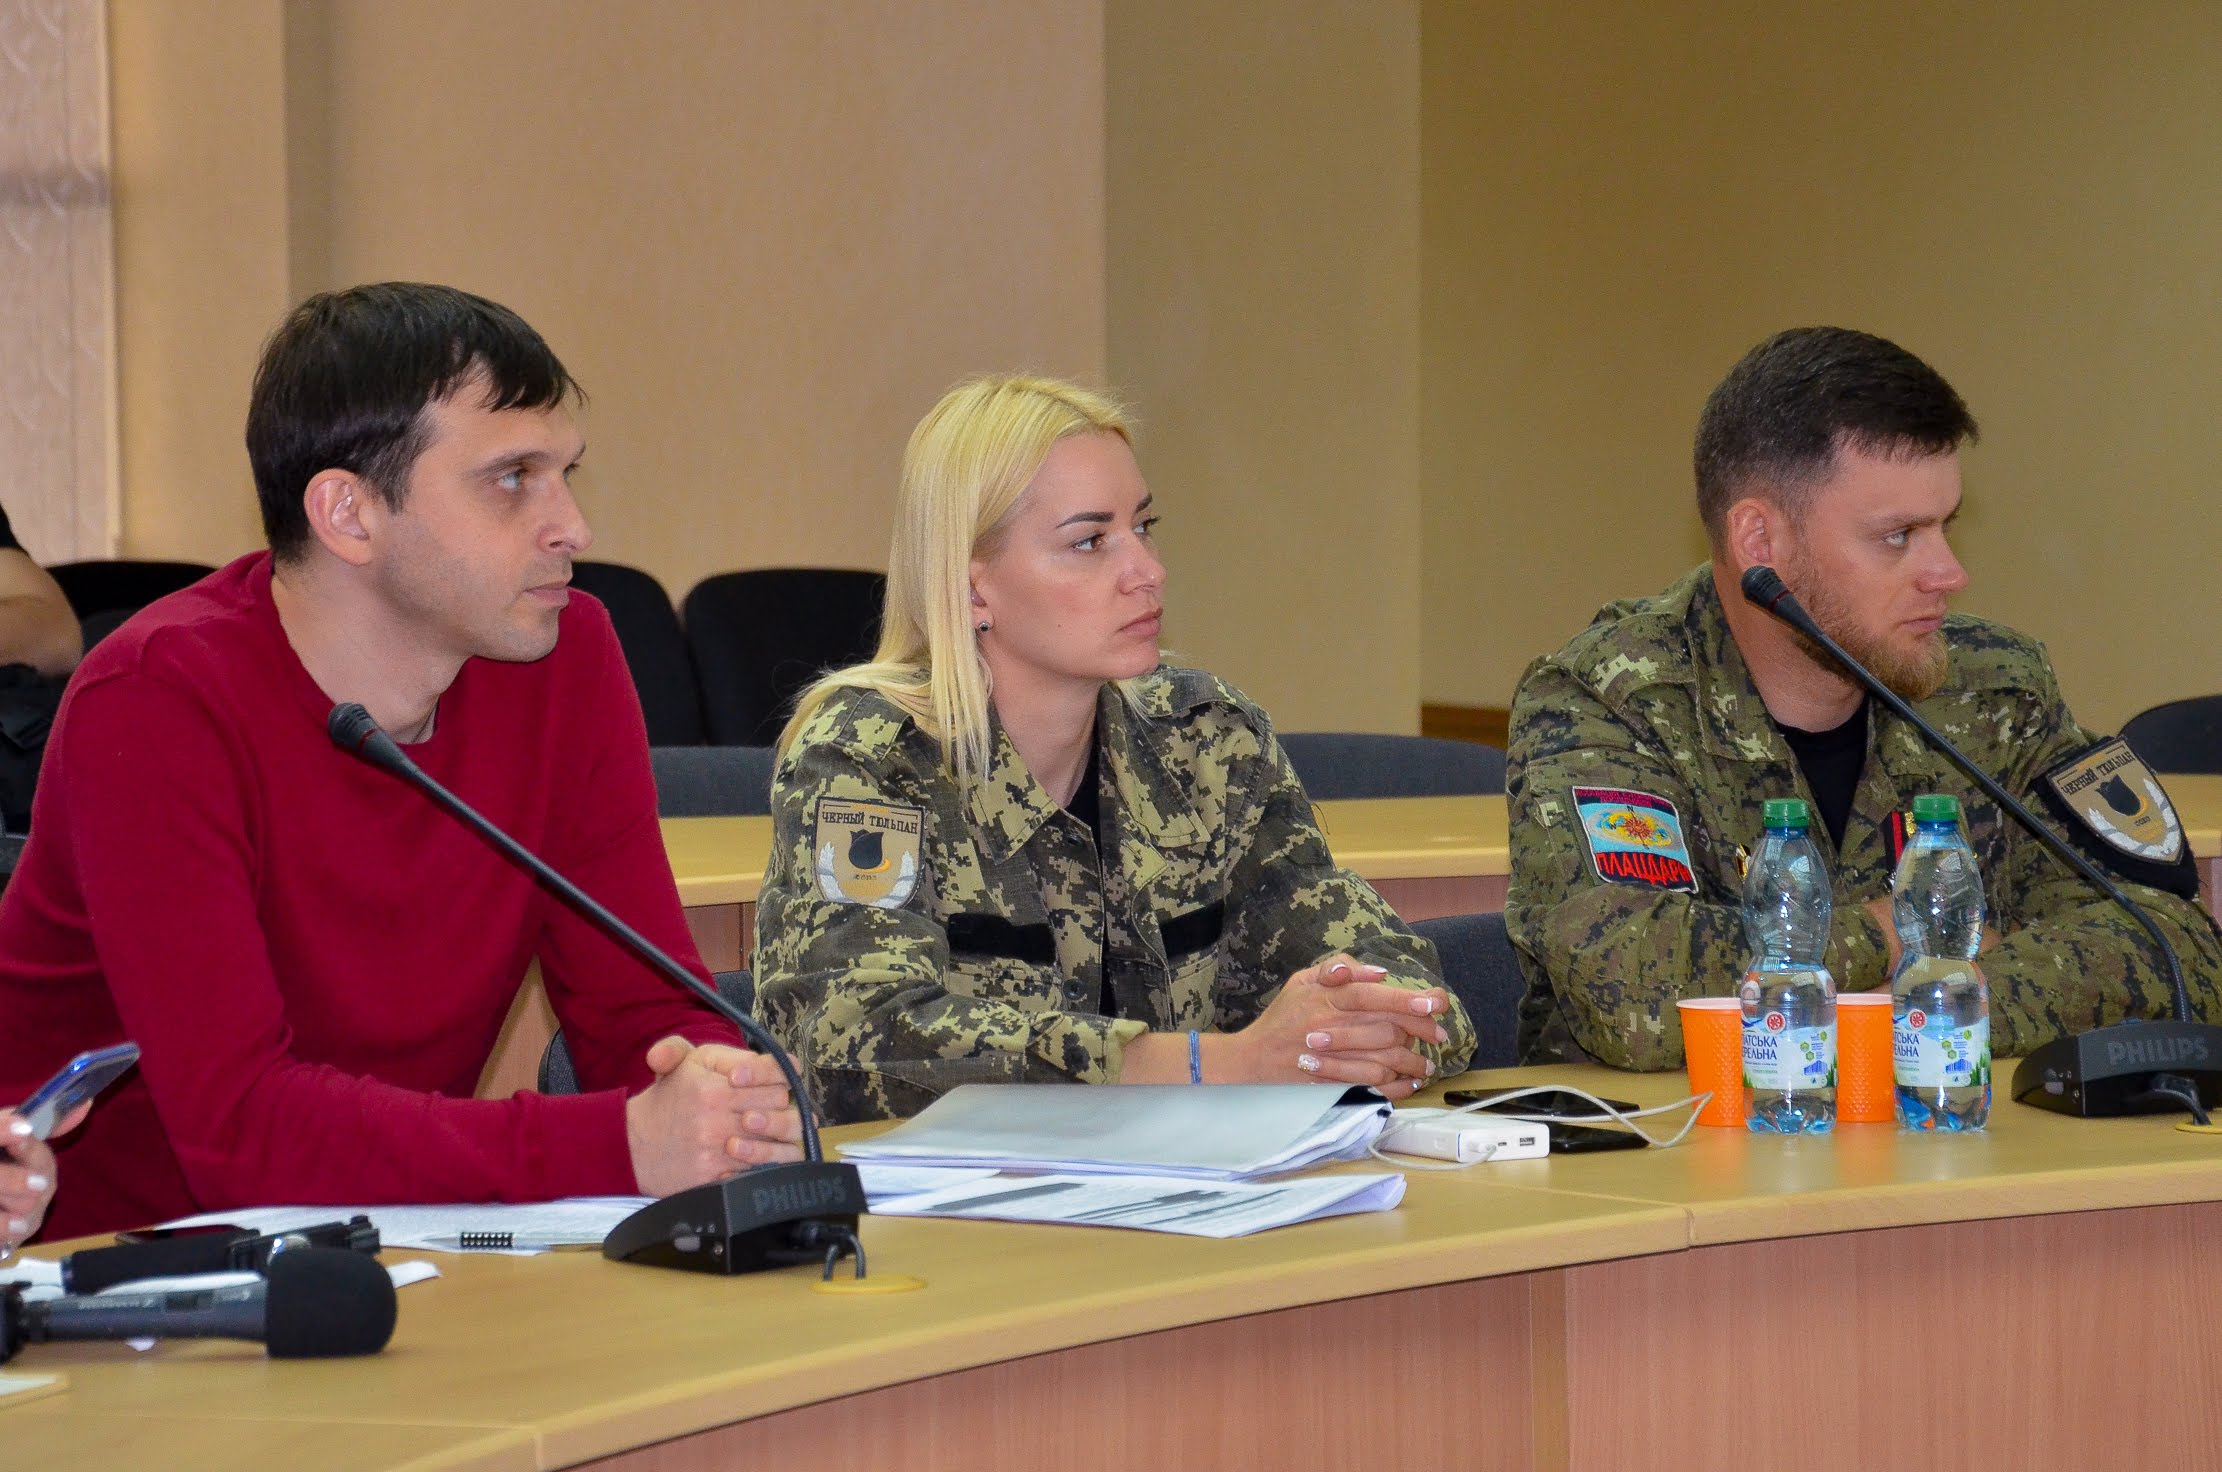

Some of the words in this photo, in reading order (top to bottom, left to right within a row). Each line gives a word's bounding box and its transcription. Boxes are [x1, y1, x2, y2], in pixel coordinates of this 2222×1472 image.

[2061, 768, 2099, 795] ЧЕРНЫЙ
[2096, 751, 2135, 776] ТЮЛЬПАН
[821, 812, 865, 826] ЧЕРНЫЙ
[869, 815, 918, 834] ТЮЛЬПАН
[1742, 1034, 1777, 1048] АТСЬКА
[1893, 1031, 1920, 1045] ТСЬКА
[1742, 1046, 1778, 1060] РЕЛЬНА
[2107, 1037, 2209, 1065] PHILIPS
[752, 1176, 847, 1215] PHILIPS
